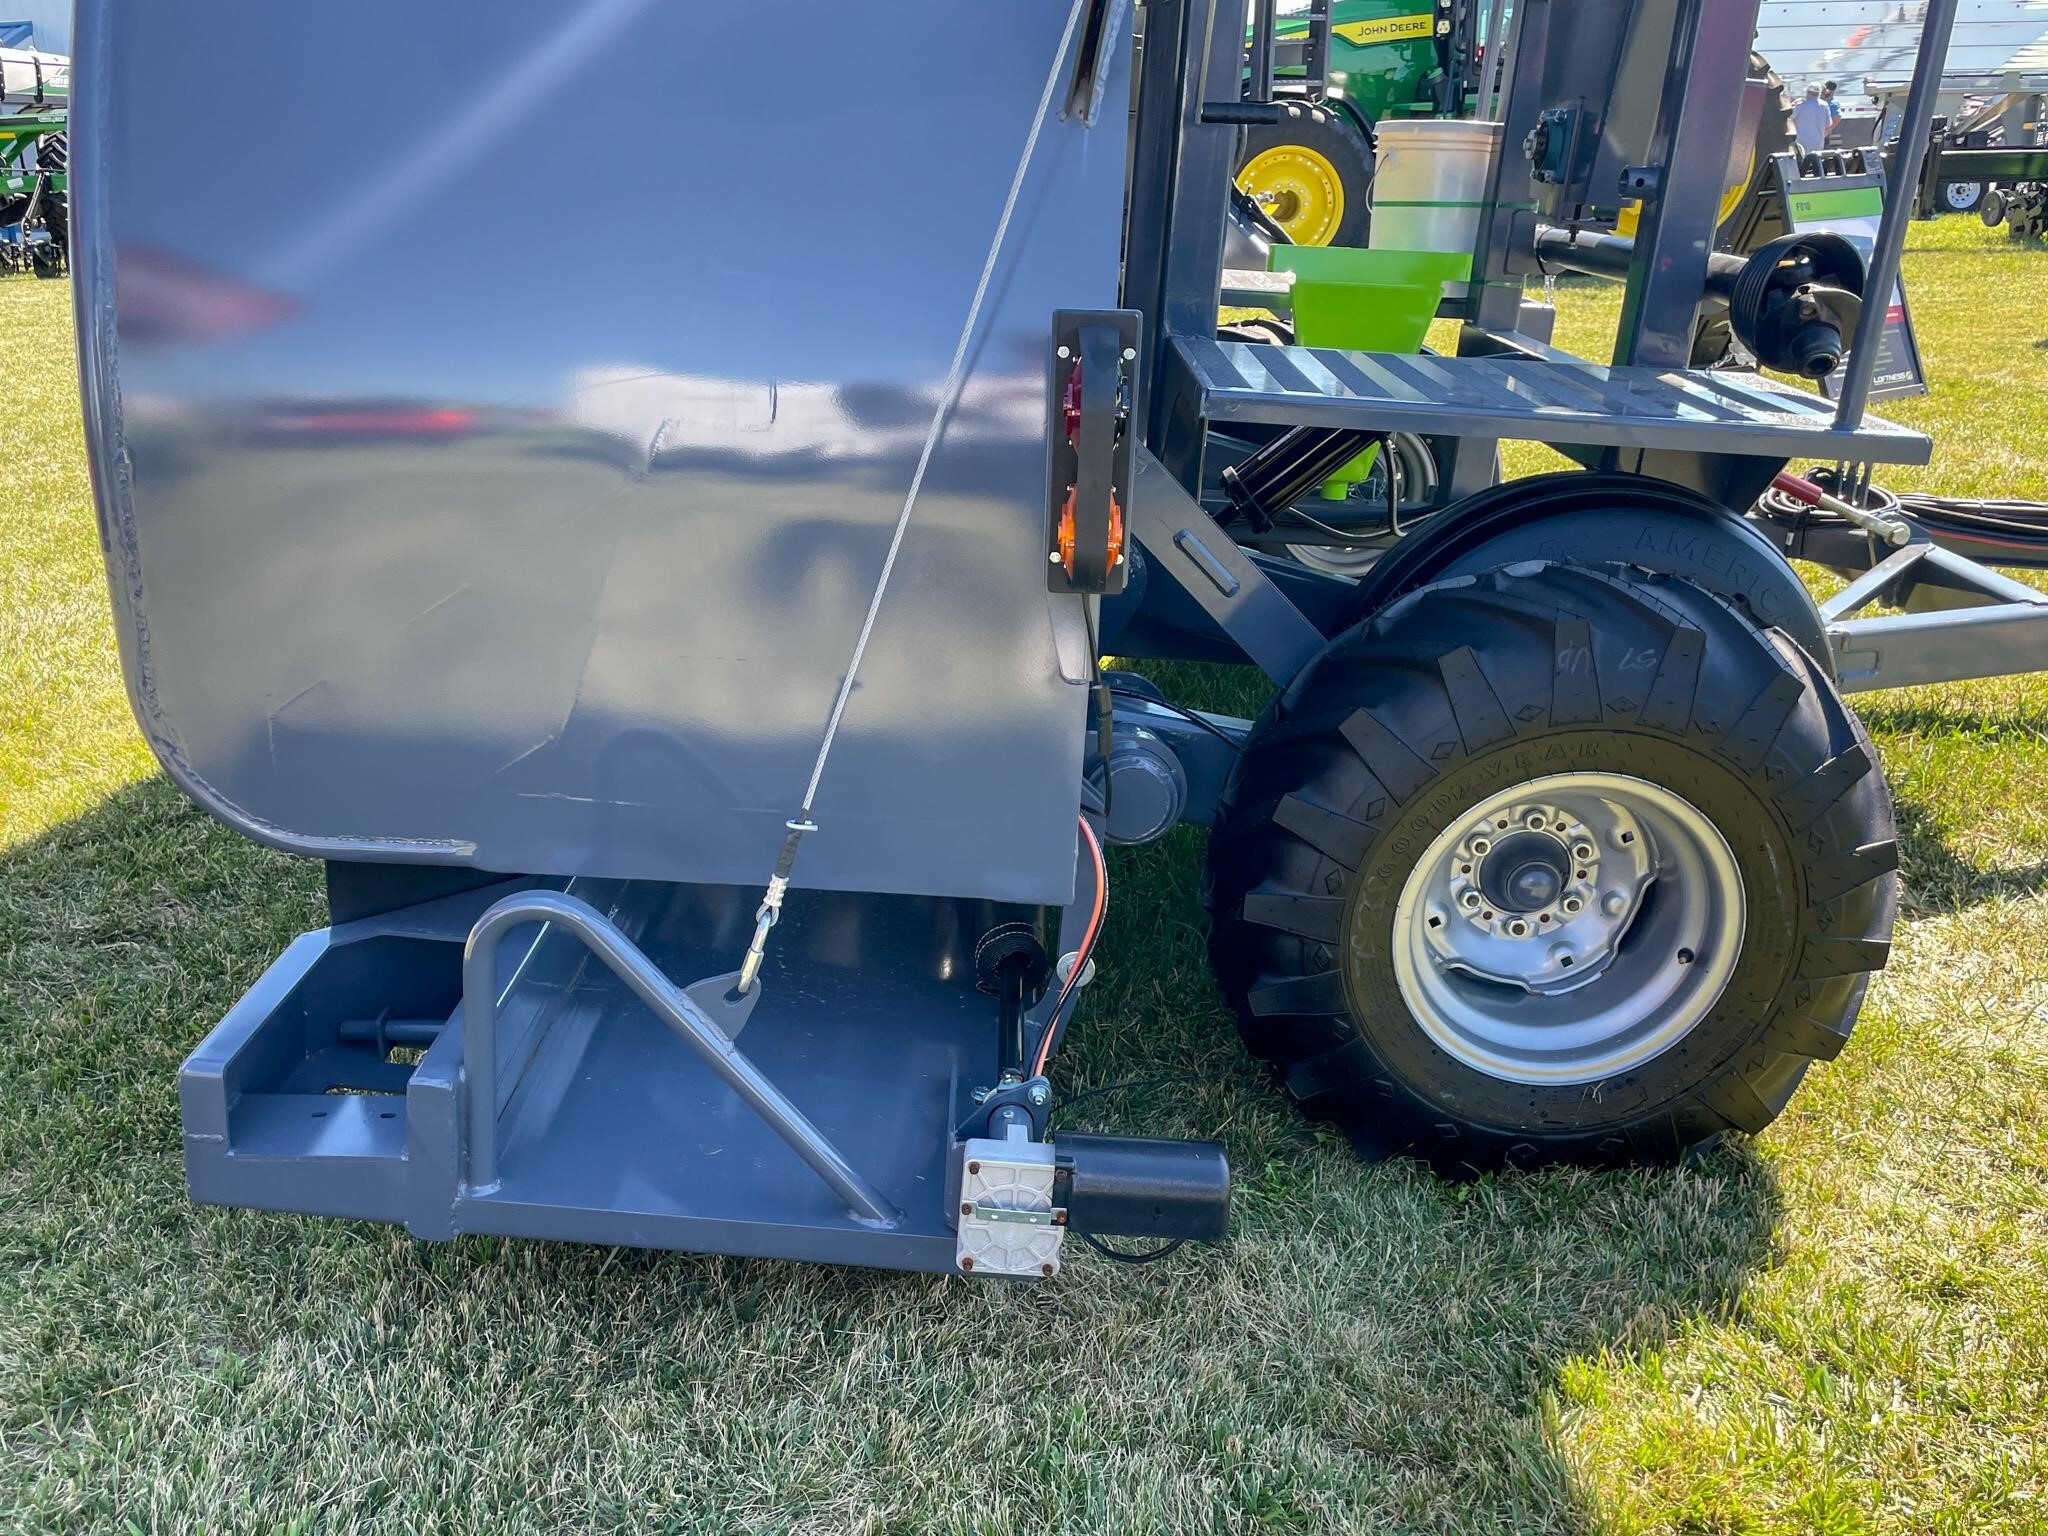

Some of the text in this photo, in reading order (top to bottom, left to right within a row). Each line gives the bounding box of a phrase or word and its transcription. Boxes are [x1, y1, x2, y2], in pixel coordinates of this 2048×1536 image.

[1357, 21, 1426, 36] JOHN DEERE
[1872, 371, 1907, 384] LOFTNESS
[1376, 742, 1600, 880] GOODYEAR
